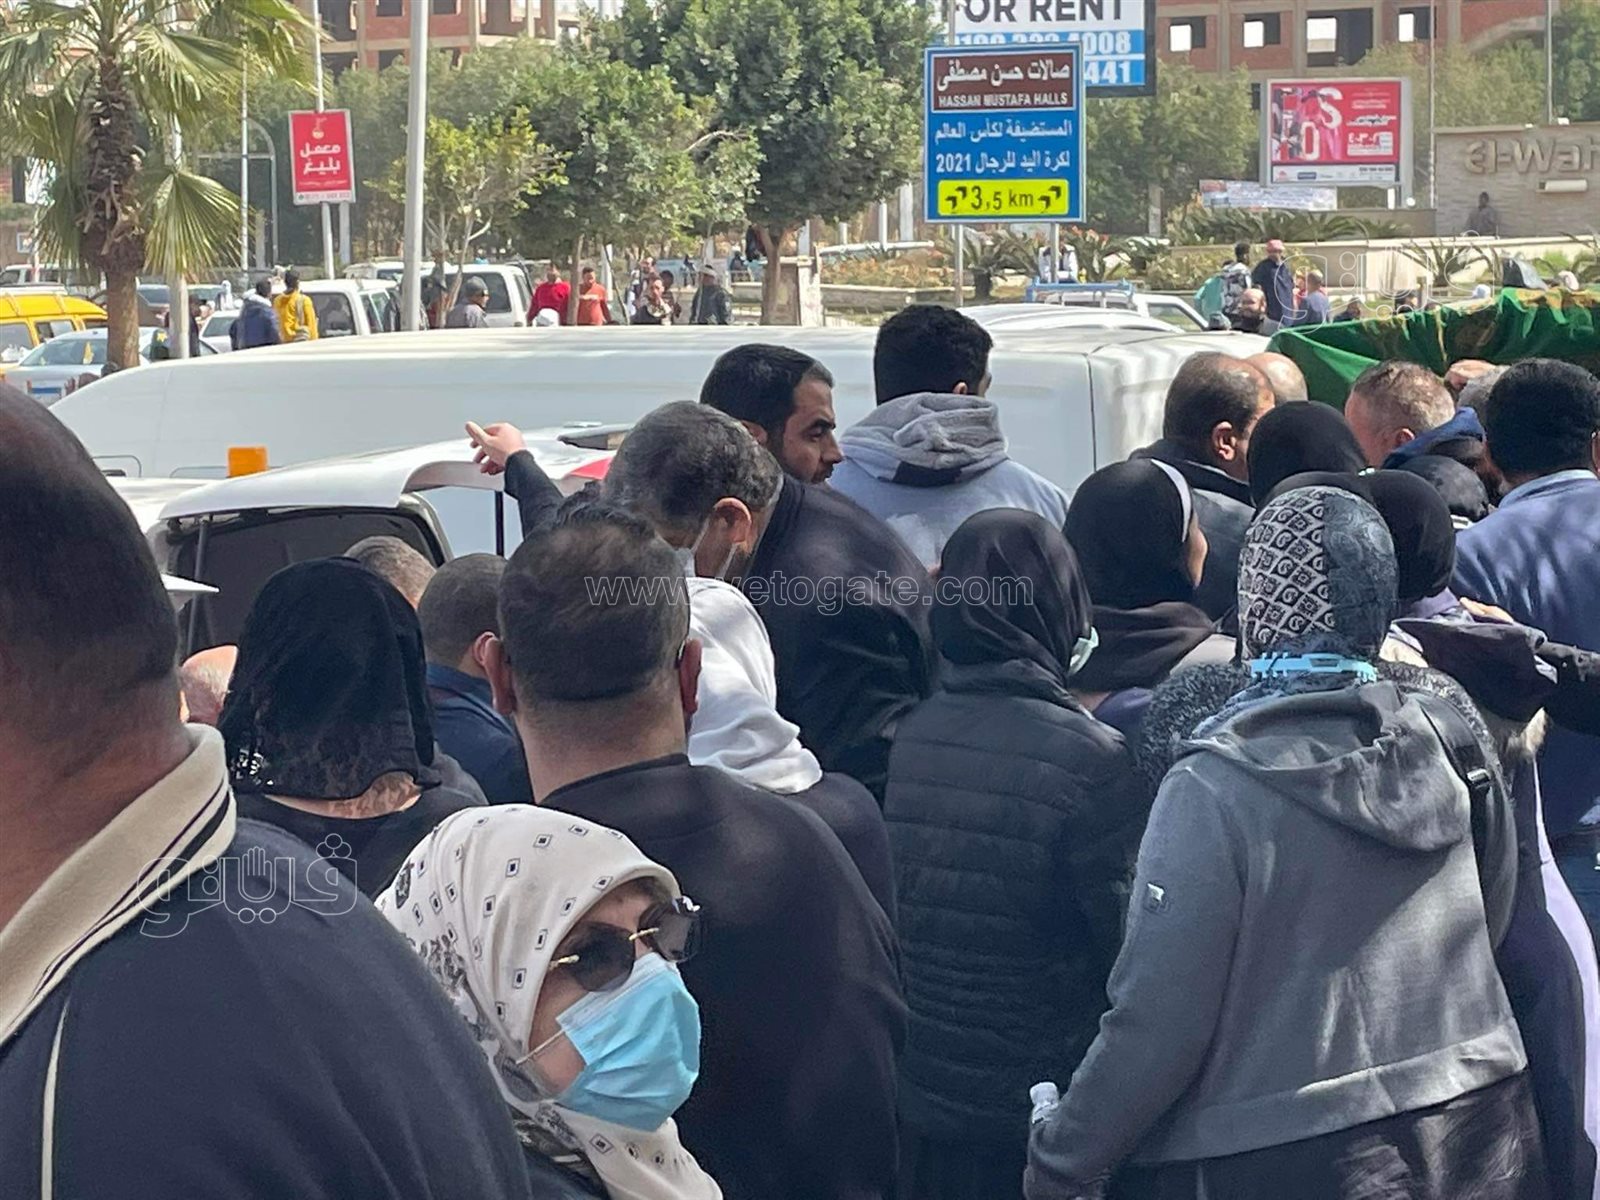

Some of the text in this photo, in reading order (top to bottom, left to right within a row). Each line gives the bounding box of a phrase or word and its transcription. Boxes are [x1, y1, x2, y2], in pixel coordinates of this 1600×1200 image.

[937, 59, 1070, 91] صالات حسن مصطفى
[938, 92, 1068, 107] HASSAN MUSTAFA HALLS
[934, 118, 1072, 145] المستضيفة لكأس العالم
[300, 142, 341, 158] معمل
[935, 150, 1071, 174] لكرة اليد للرجال 2021
[971, 185, 1034, 210] 3,5 km
